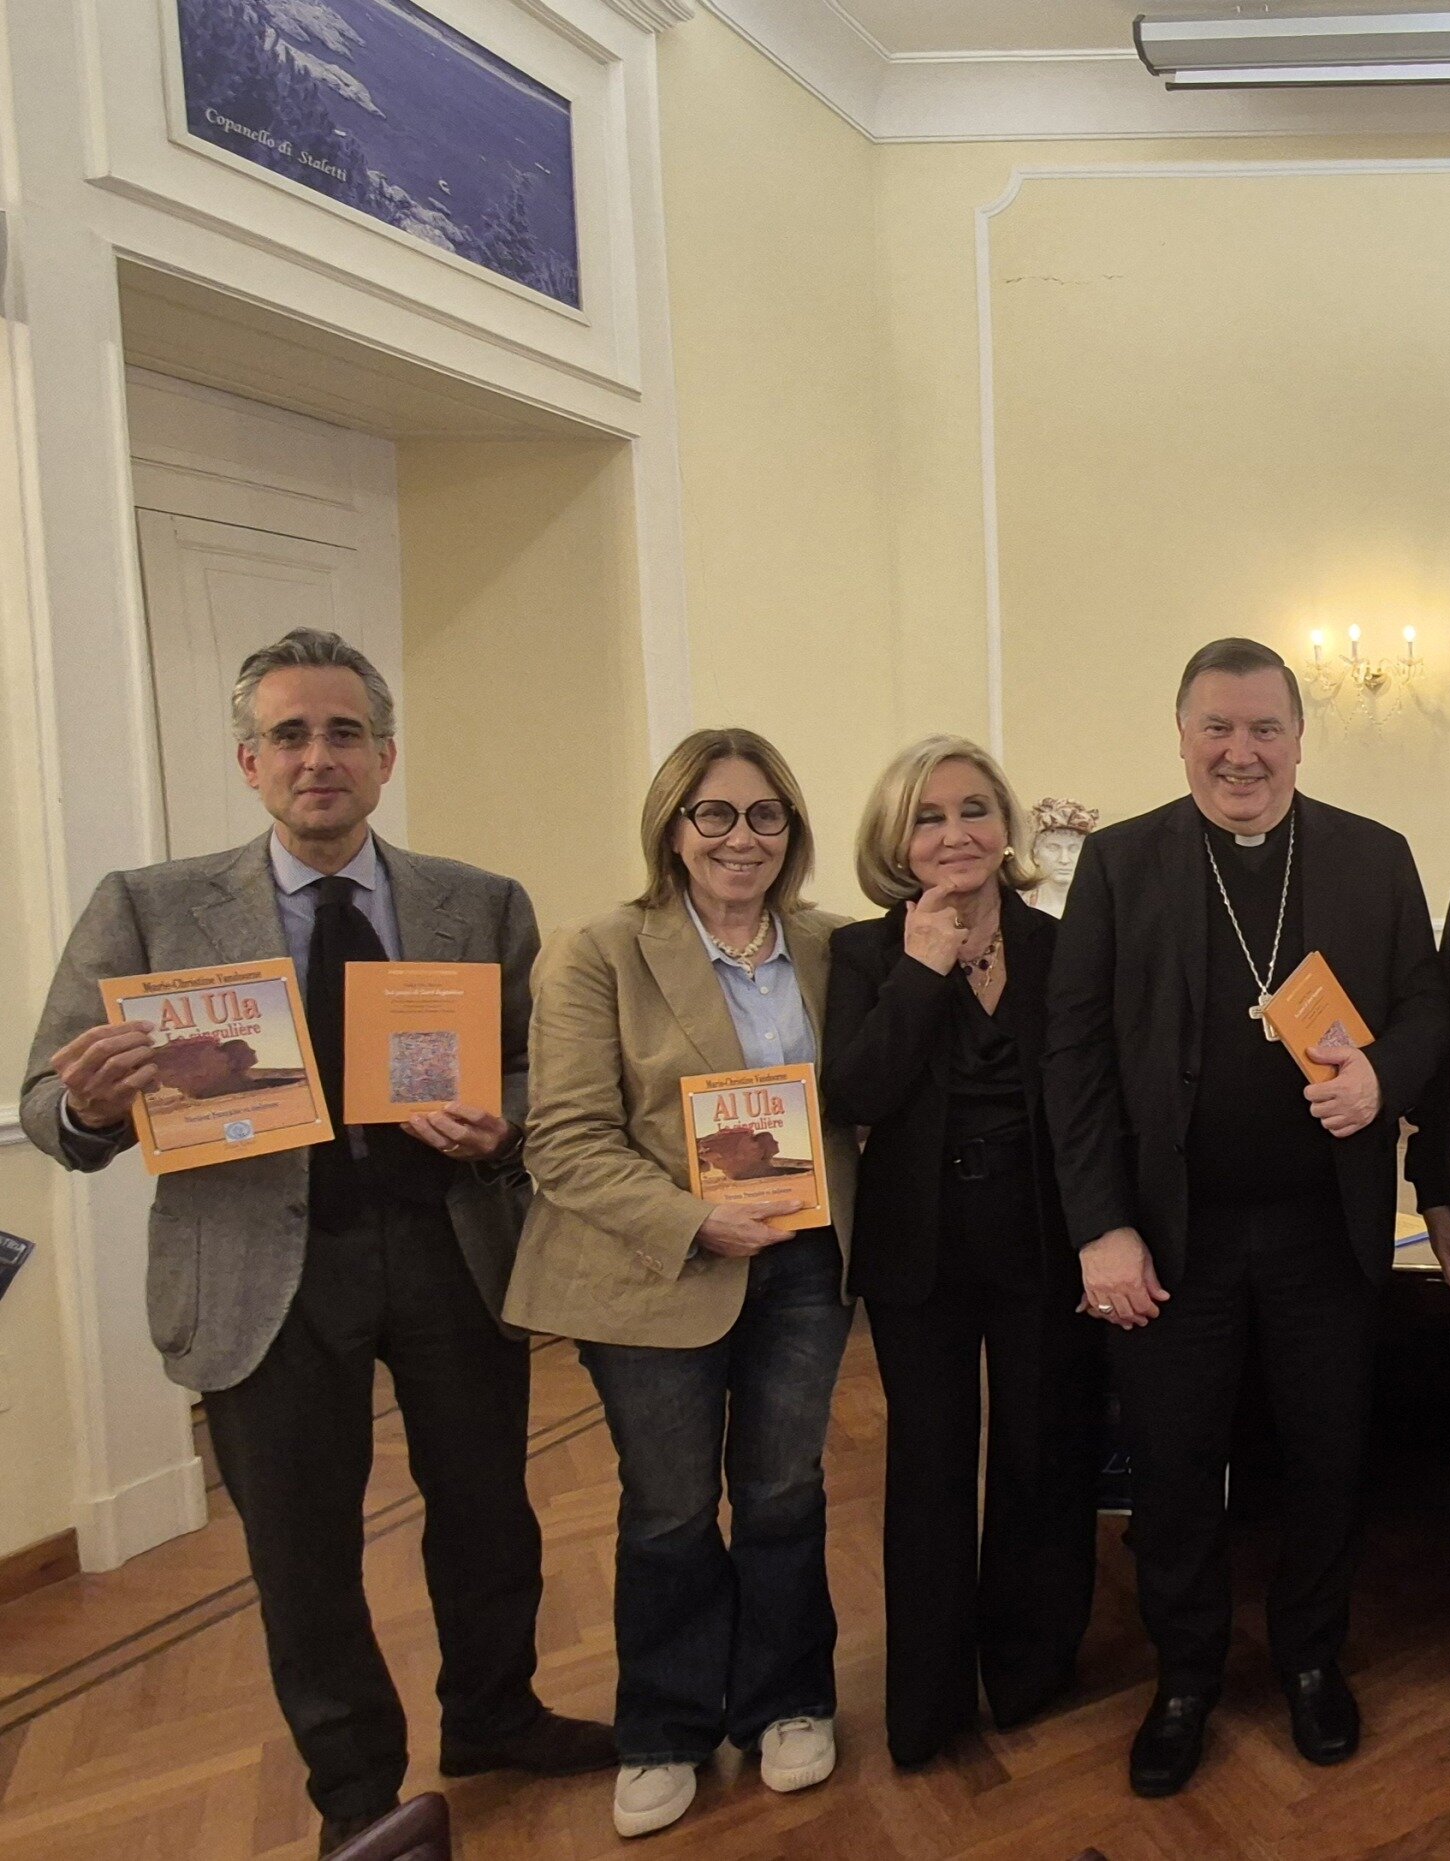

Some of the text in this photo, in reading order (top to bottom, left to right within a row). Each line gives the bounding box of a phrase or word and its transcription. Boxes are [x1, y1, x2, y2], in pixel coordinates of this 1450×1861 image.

[205, 107, 275, 149] Copanello
[278, 141, 292, 156] di
[159, 989, 262, 1032] Al Ula
[713, 1088, 785, 1122] Al Ula
